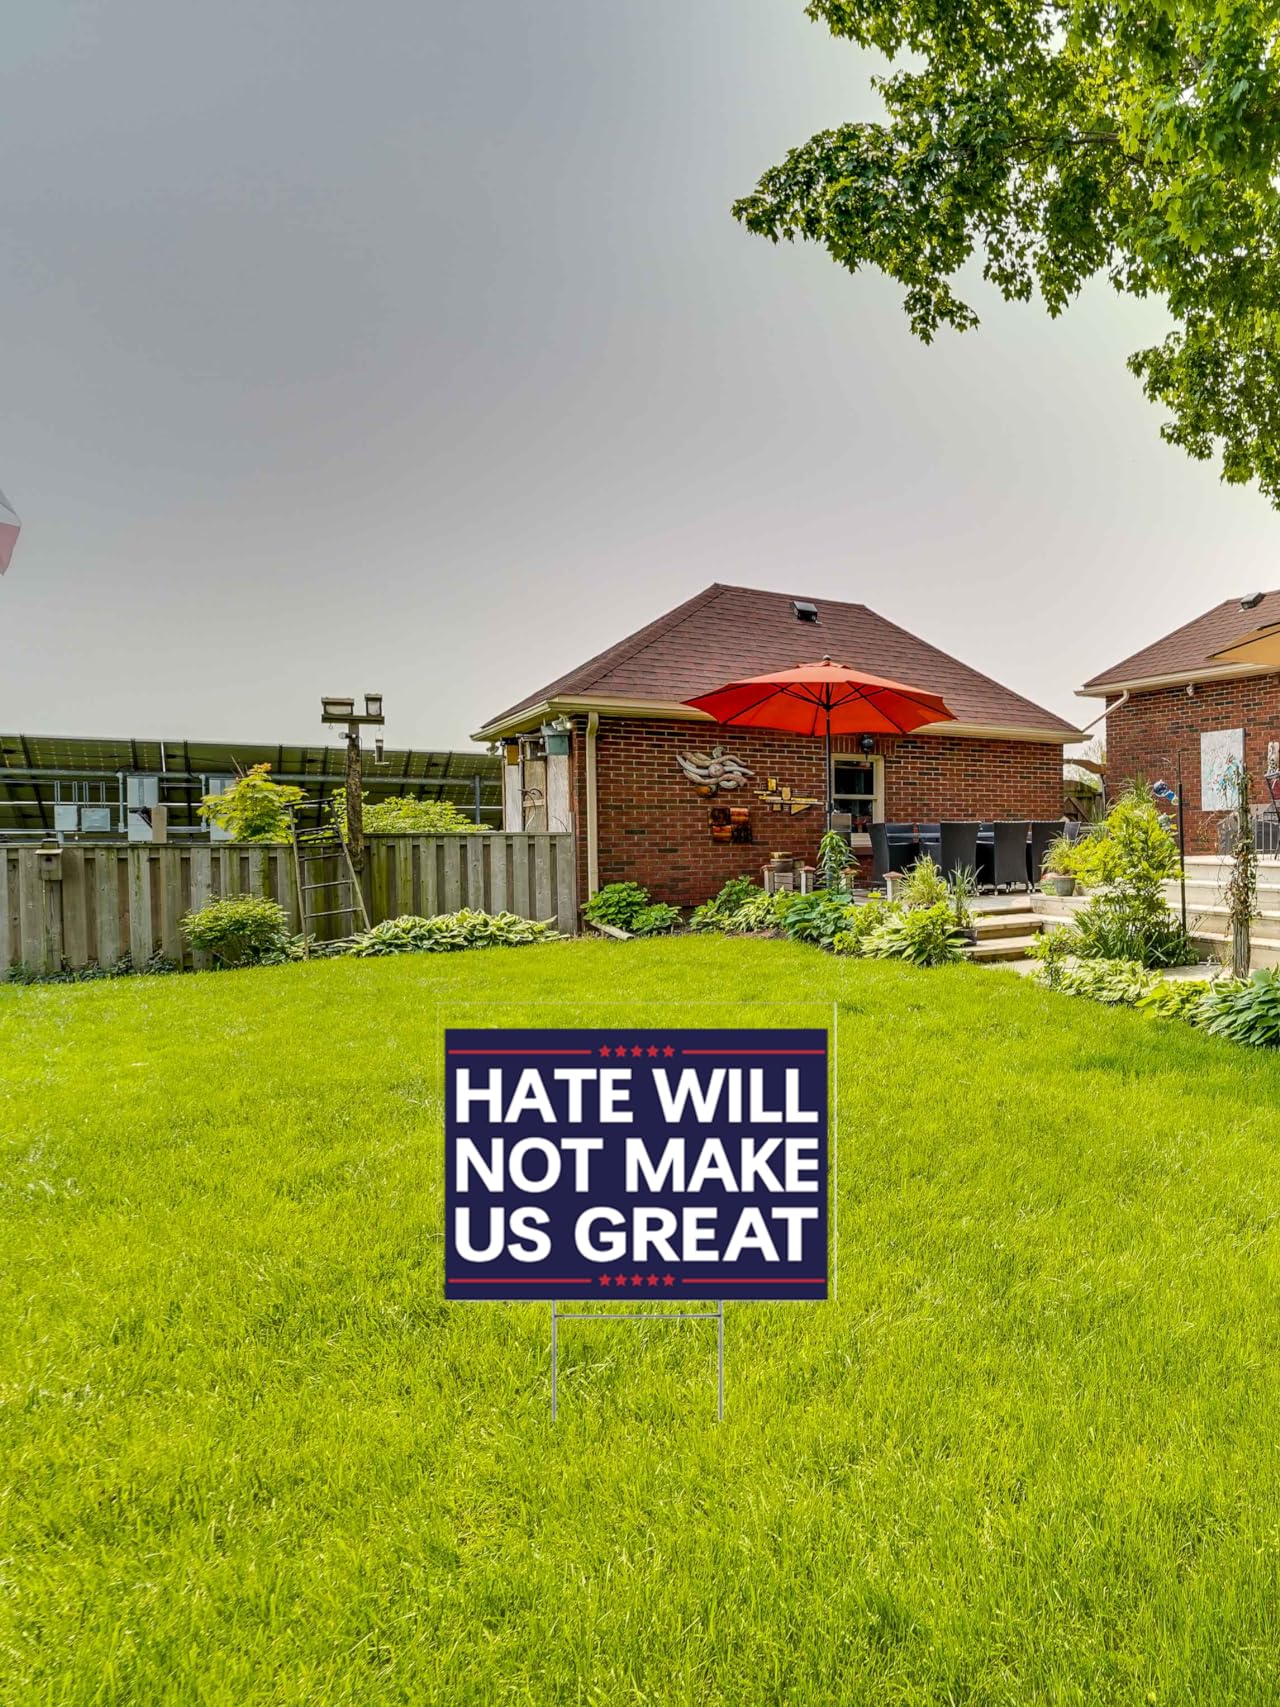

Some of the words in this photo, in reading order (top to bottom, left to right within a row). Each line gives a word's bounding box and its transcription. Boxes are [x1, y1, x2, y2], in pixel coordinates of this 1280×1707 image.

[456, 1068, 634, 1123] HATE
[652, 1068, 819, 1123] WILL
[456, 1137, 604, 1193] NOT
[625, 1137, 819, 1193] MAKE
[455, 1207, 552, 1262] US
[574, 1206, 819, 1263] GREAT
